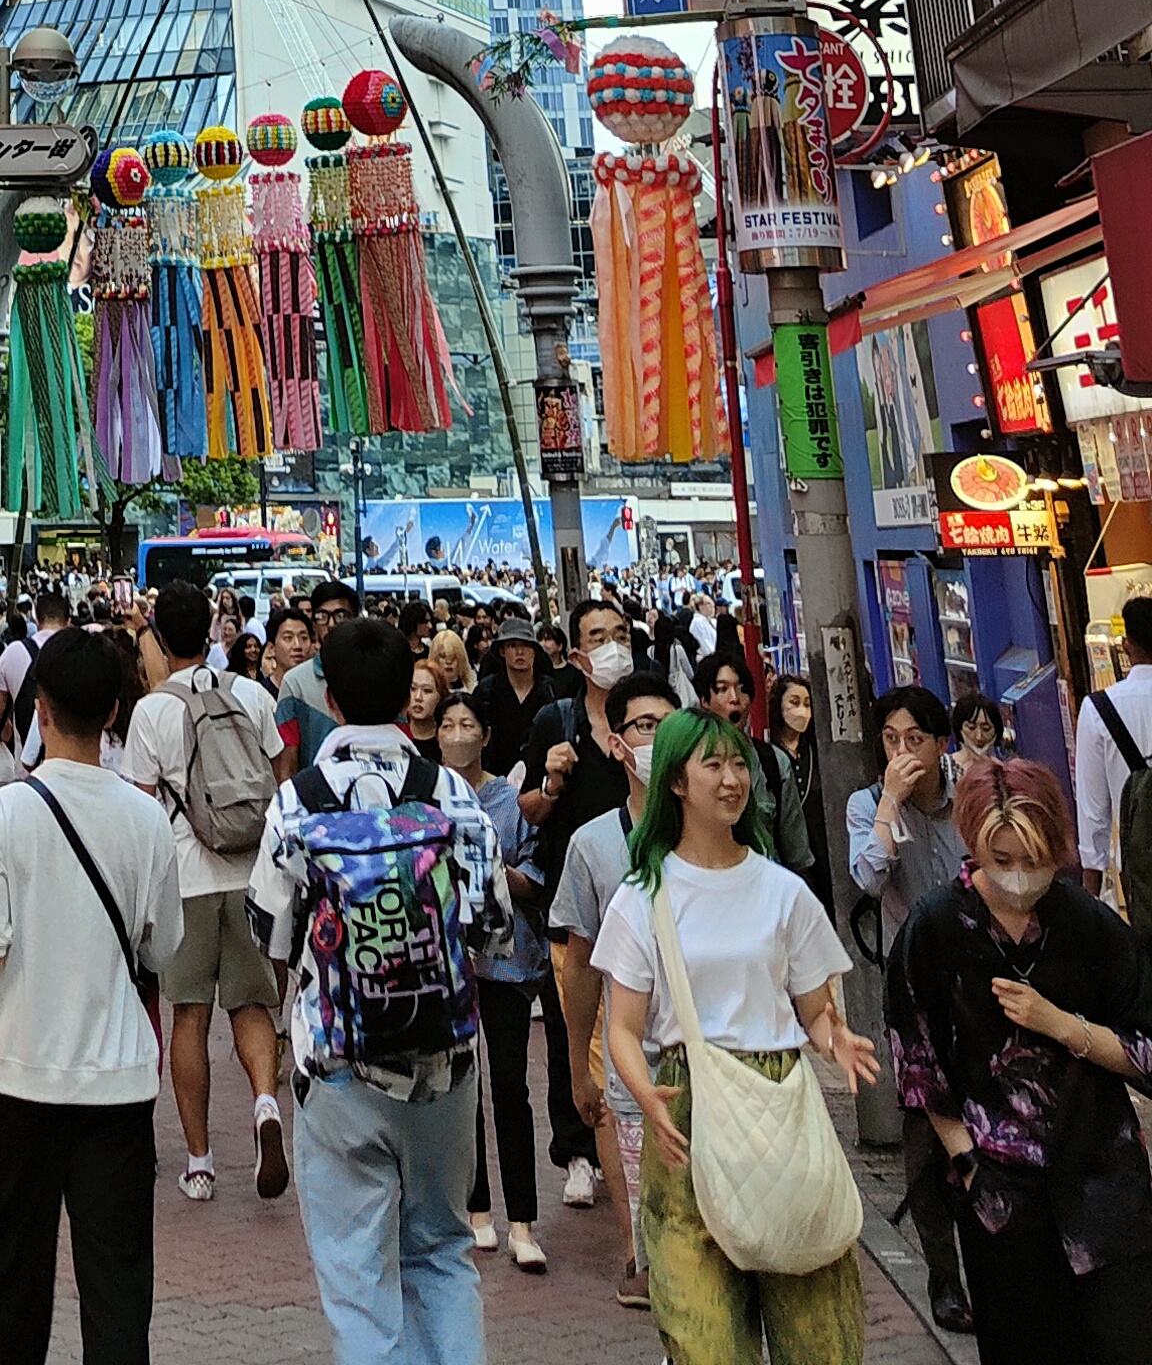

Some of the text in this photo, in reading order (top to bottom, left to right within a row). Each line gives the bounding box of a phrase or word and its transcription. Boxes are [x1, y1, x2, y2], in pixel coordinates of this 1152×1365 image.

[775, 37, 834, 206] 七夕まつり
[745, 213, 778, 228] STAR
[798, 333, 833, 469] 客引きは犯罪です
[478, 537, 518, 555] Water
[834, 693, 847, 736] ストリート
[350, 901, 383, 995] FACE
